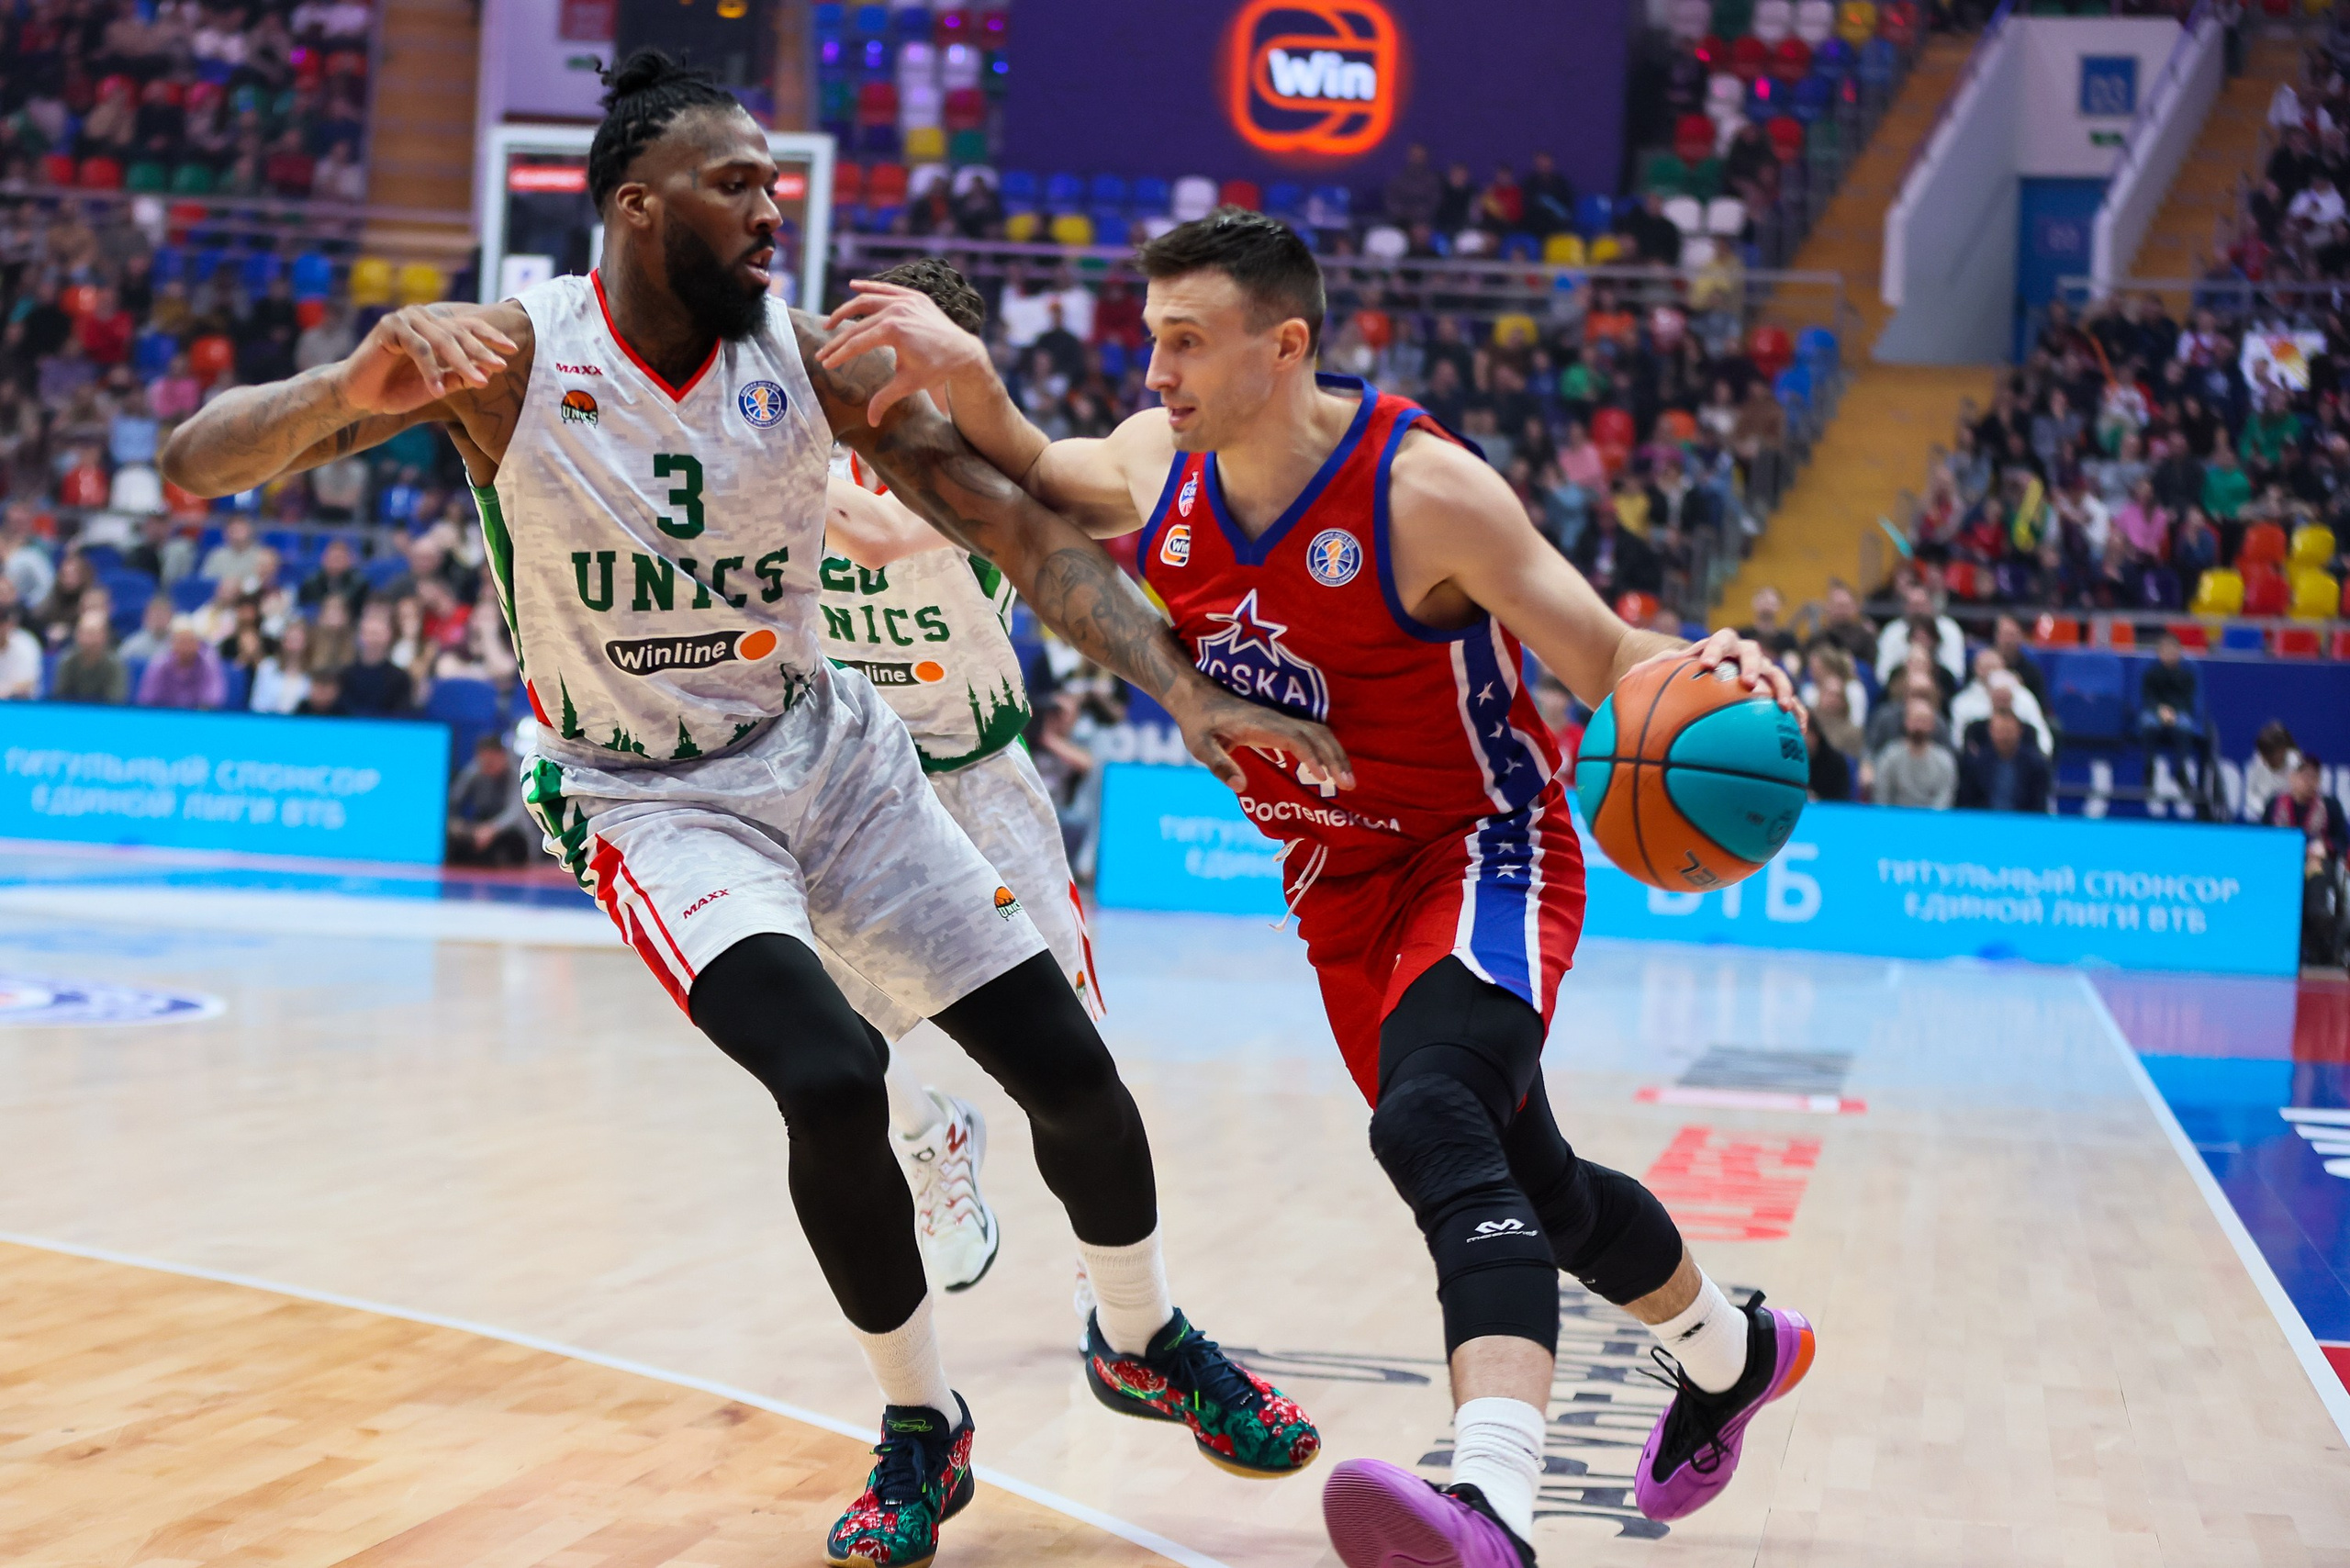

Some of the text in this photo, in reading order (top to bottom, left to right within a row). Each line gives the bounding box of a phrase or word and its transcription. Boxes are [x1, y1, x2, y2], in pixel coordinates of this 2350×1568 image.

[1268, 48, 1377, 101] Win
[555, 362, 604, 376] MAXX
[653, 454, 706, 540] 3
[571, 545, 789, 612] UNICS
[819, 603, 951, 646] NICS
[614, 640, 726, 670] Winline
[857, 664, 908, 683] line
[683, 889, 730, 920] MAXX
